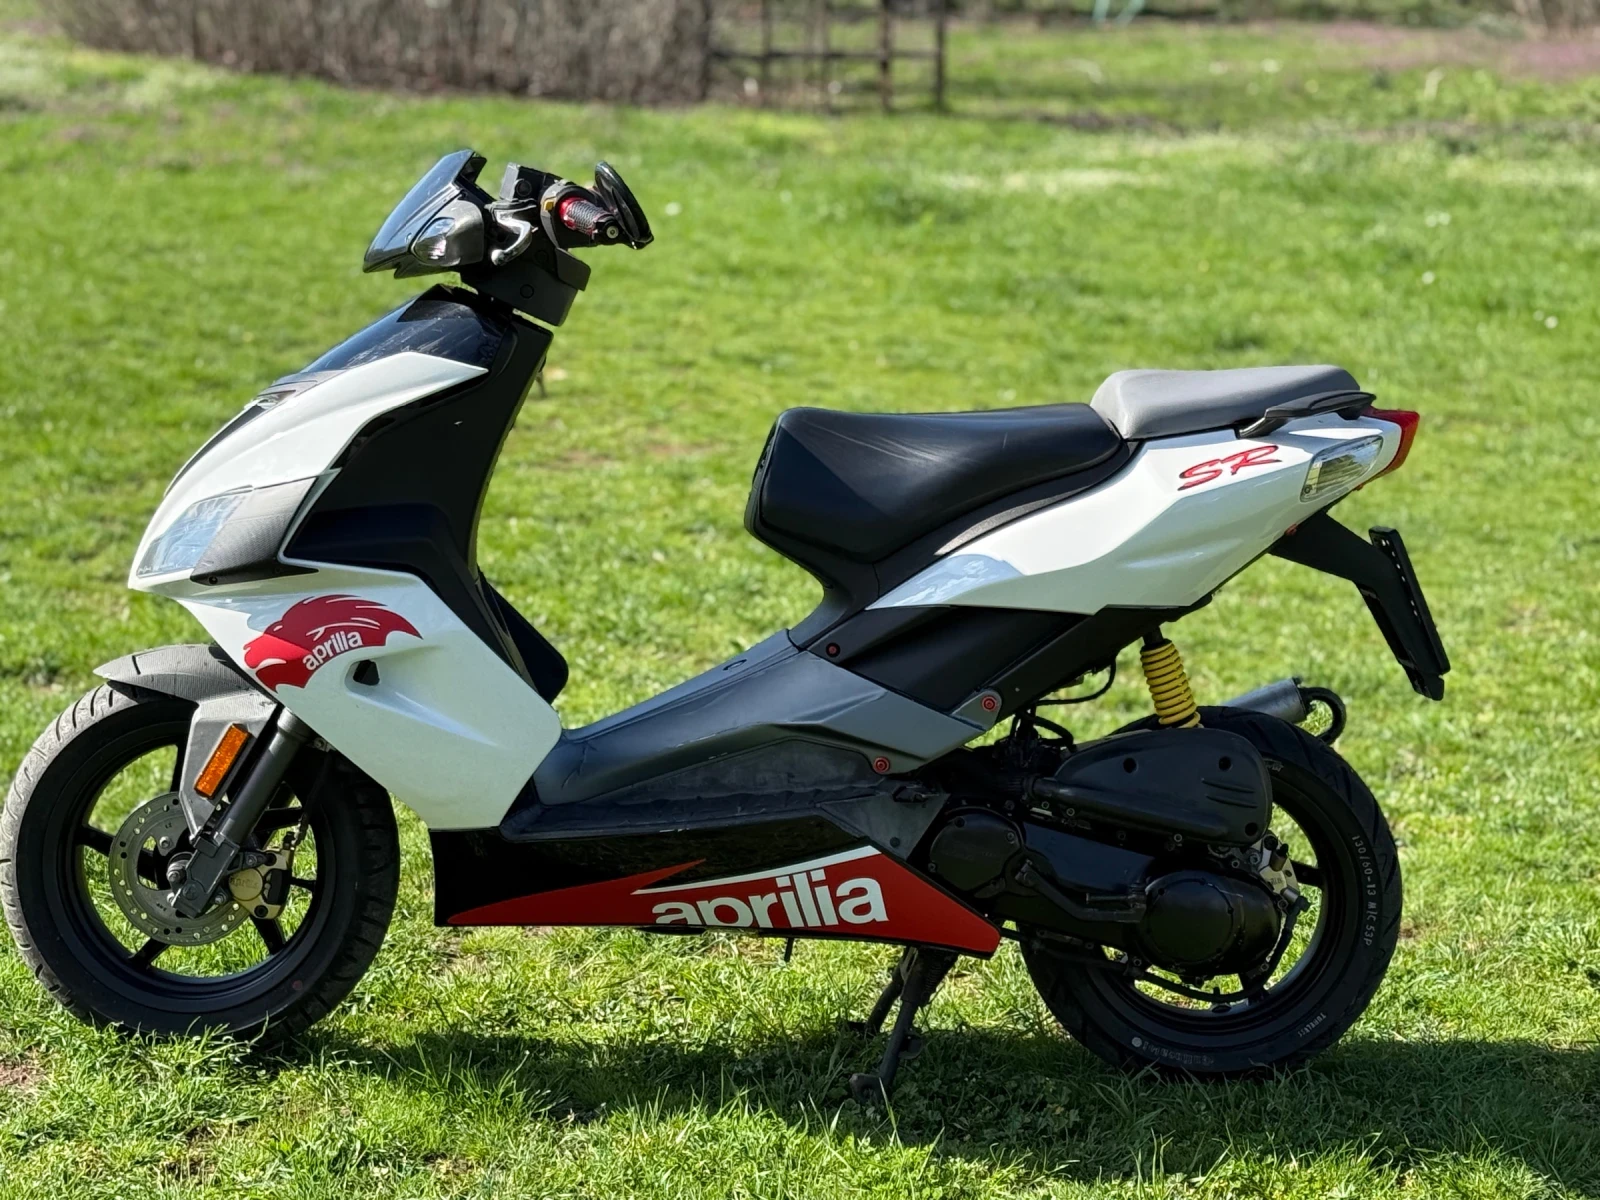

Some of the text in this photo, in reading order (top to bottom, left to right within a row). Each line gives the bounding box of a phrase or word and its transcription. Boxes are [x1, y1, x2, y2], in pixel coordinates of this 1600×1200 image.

[1177, 445, 1282, 491] SR
[302, 631, 364, 671] aprilia
[651, 868, 889, 928] aprilia
[1352, 835, 1378, 946] 130/60-13 M/C 53P
